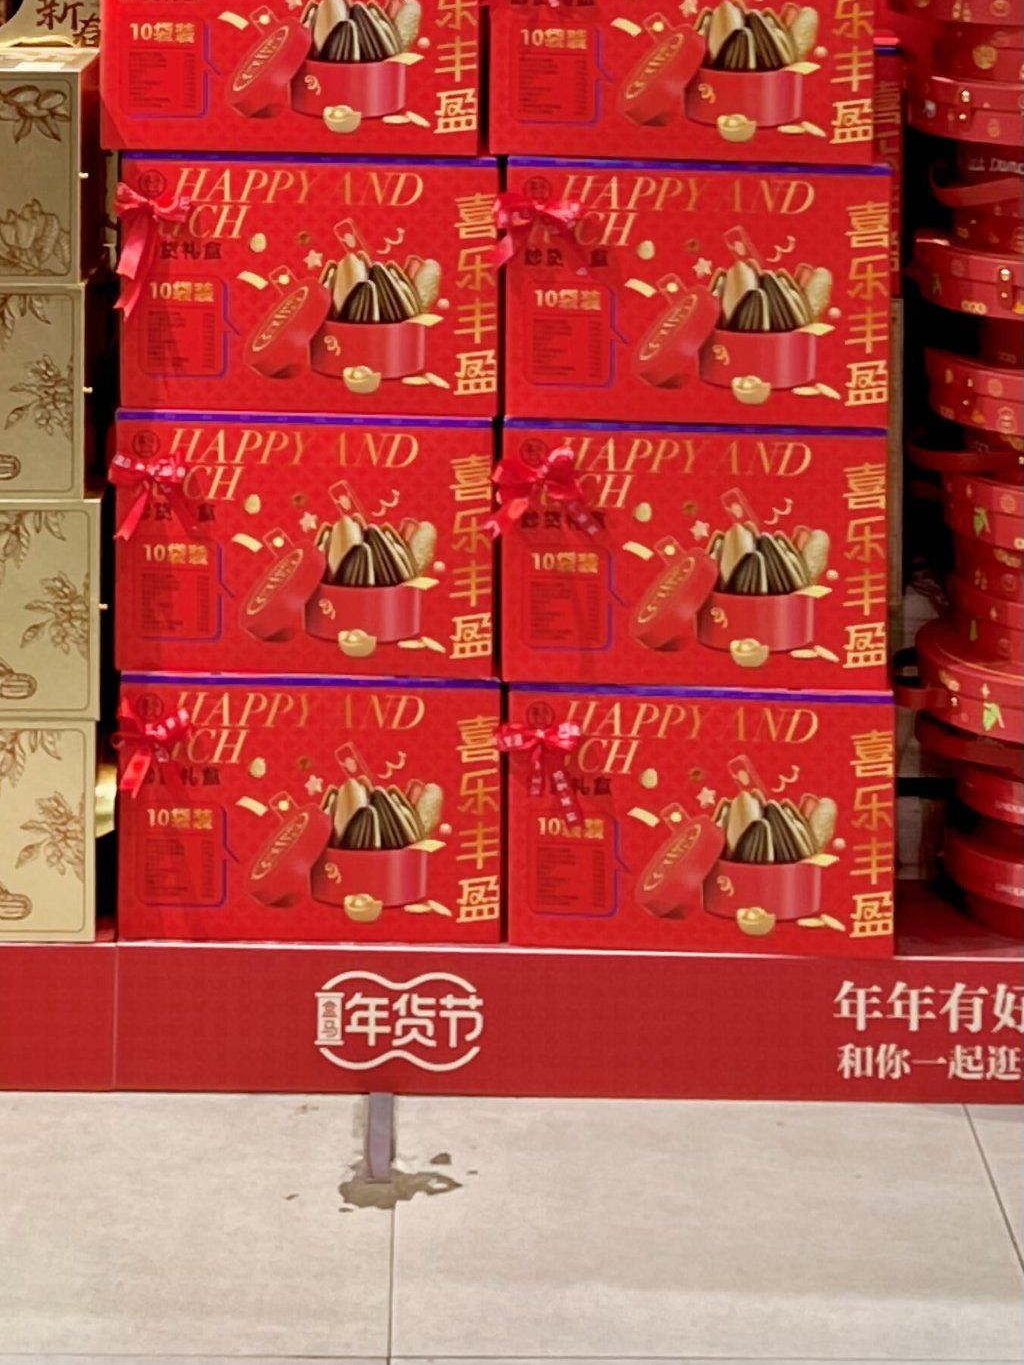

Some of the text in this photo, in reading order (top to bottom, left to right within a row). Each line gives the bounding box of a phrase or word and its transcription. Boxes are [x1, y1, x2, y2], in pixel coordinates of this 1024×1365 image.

[129, 21, 195, 44] 10袋装
[520, 27, 588, 50] 10袋装
[176, 167, 424, 207] HAPPY AND
[561, 174, 815, 215] HAPPY AND
[148, 281, 215, 303] 10袋装
[452, 192, 498, 396] 喜乐丰盈
[534, 289, 602, 311] 10袋装
[843, 200, 890, 407] 喜乐丰盈
[169, 428, 419, 468] HAPPY AND
[715, 441, 812, 476] AND
[143, 542, 209, 566] 10袋装
[449, 454, 492, 660] 喜乐丰盈
[531, 551, 599, 574] 10袋装
[842, 462, 887, 669] 喜乐丰盈
[176, 692, 426, 729] HAPPY AND
[566, 700, 820, 744] HAPPY AND
[147, 808, 214, 830] 10袋装
[455, 714, 500, 924] 喜乐丰盈
[849, 729, 894, 938] 喜乐丰盈
[345, 992, 484, 1048] 年货节
[837, 1042, 1023, 1081] 和你一起逛
